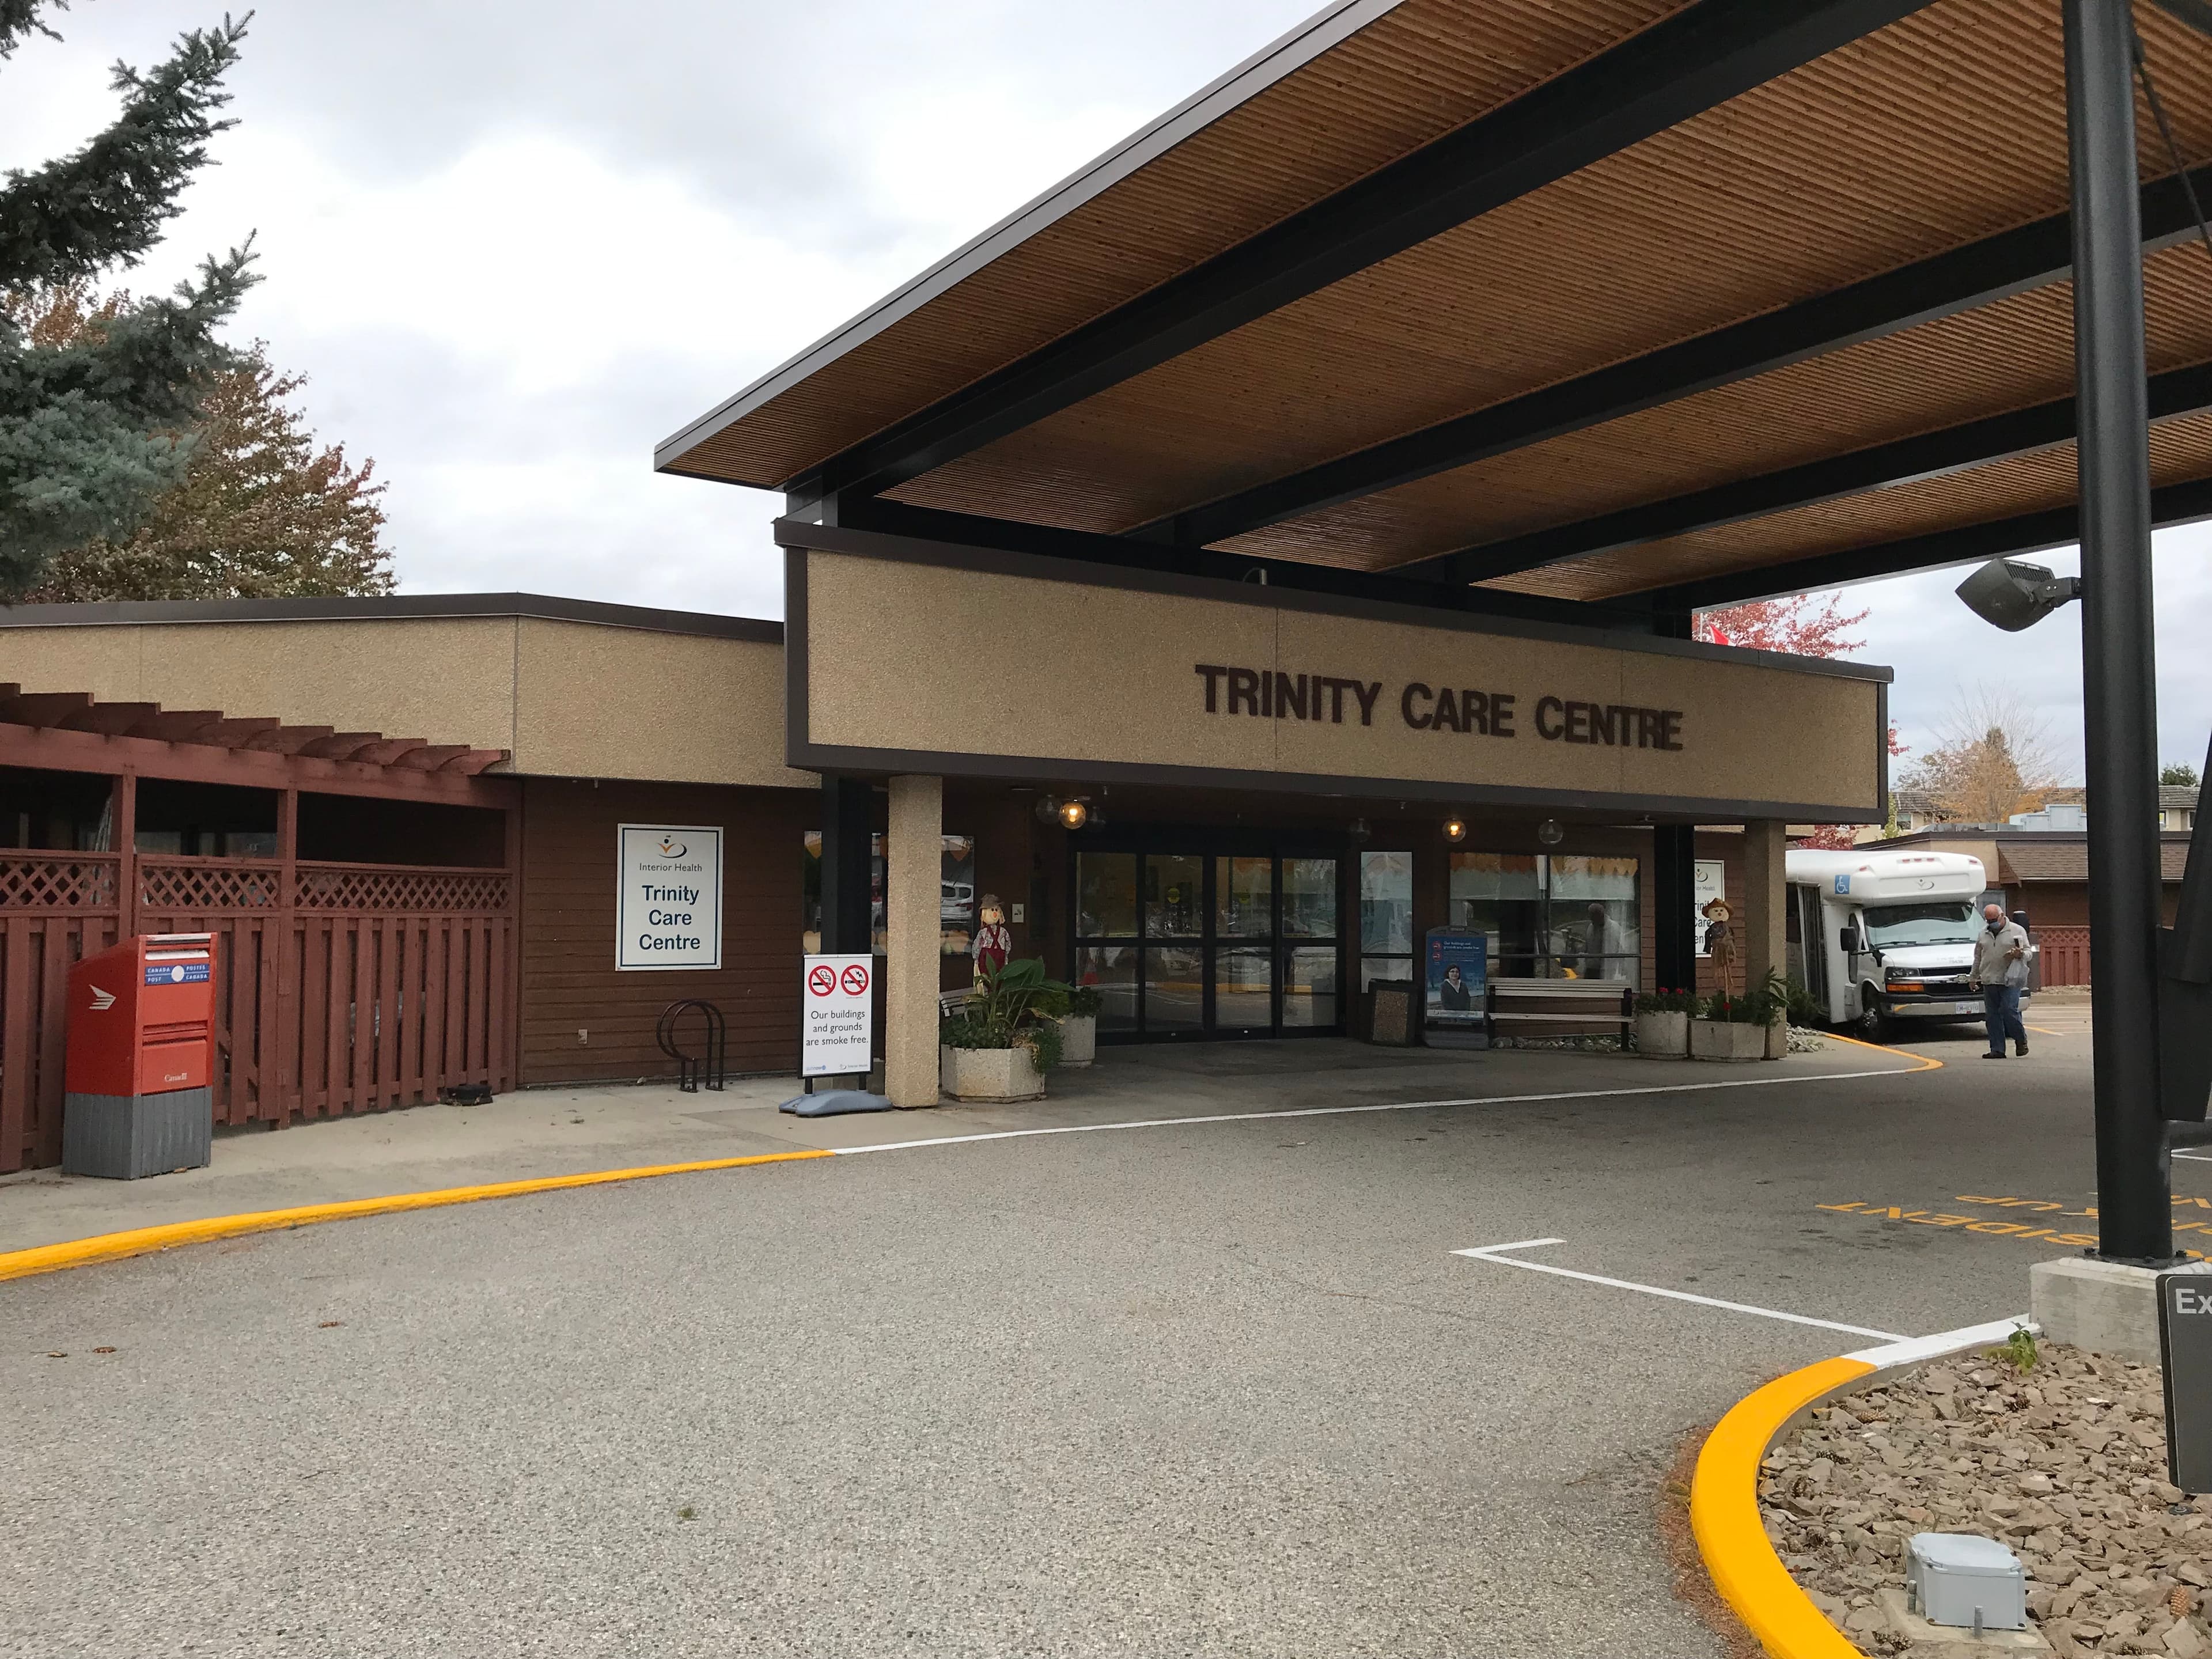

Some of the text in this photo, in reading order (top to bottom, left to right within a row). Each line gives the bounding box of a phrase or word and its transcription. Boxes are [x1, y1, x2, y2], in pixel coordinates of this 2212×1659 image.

[1195, 664, 1683, 751] TRINITY CARE CENTRE
[639, 863, 702, 872] Interior Health
[642, 885, 699, 905] Trinity
[649, 909, 692, 925] Care
[639, 934, 700, 950] Centre
[811, 1010, 865, 1020] Our buildings
[813, 1022, 862, 1034] and grounds
[822, 1036, 848, 1045] smoke
[851, 1035, 868, 1044] free.
